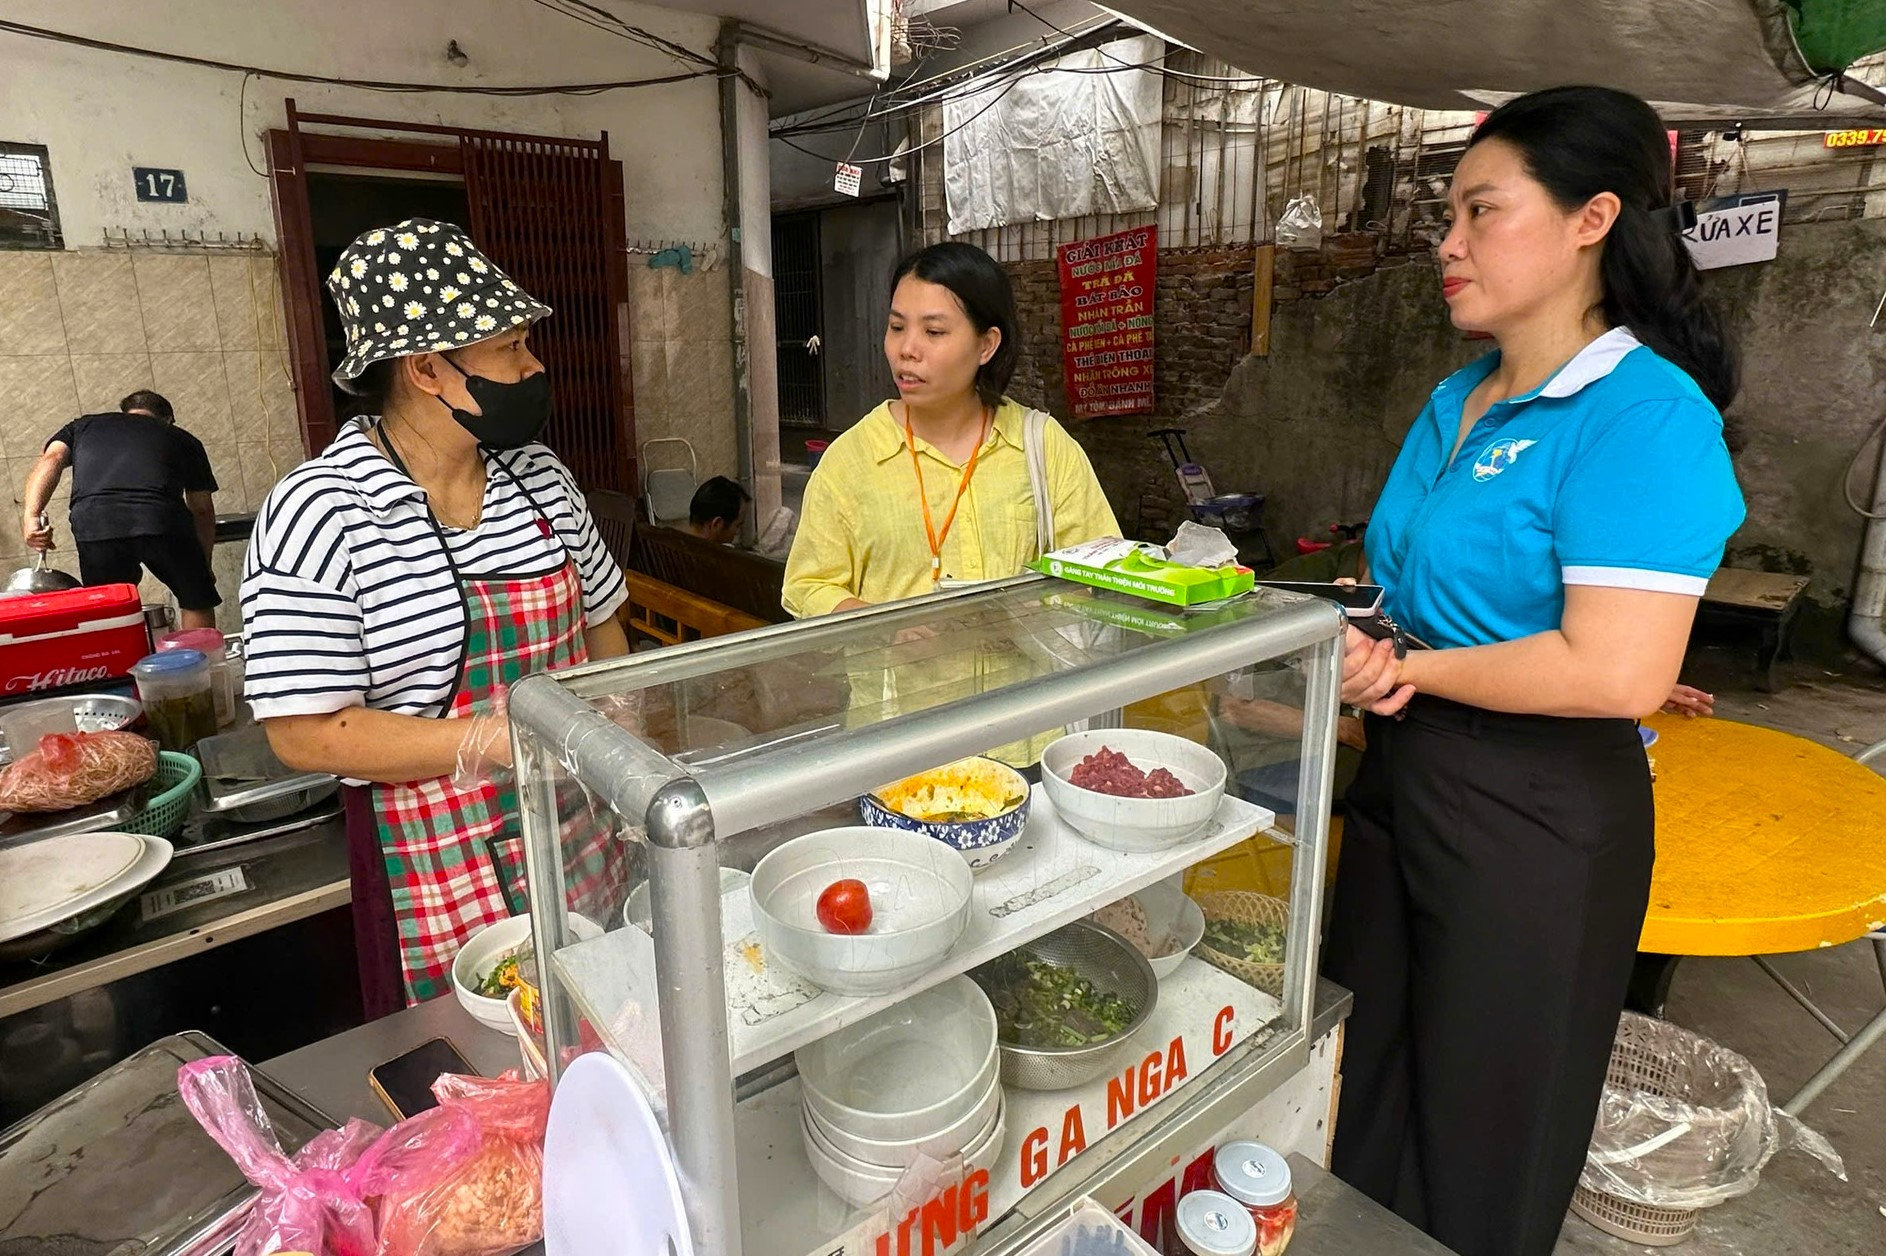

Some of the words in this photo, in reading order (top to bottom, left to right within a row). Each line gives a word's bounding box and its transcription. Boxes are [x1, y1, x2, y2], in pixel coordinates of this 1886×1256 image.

[146, 173, 175, 197] 17
[1735, 210, 1773, 236] XE
[1066, 241, 1100, 264] GIẢI
[1103, 232, 1148, 256] KHÁT
[1124, 250, 1143, 267] ĐÁ
[1108, 284, 1143, 301] BẢO
[1082, 570, 1095, 579] TAY
[5, 665, 108, 691] Hitaco
[1020, 1103, 1087, 1189] GA
[1107, 1035, 1188, 1131] NGA
